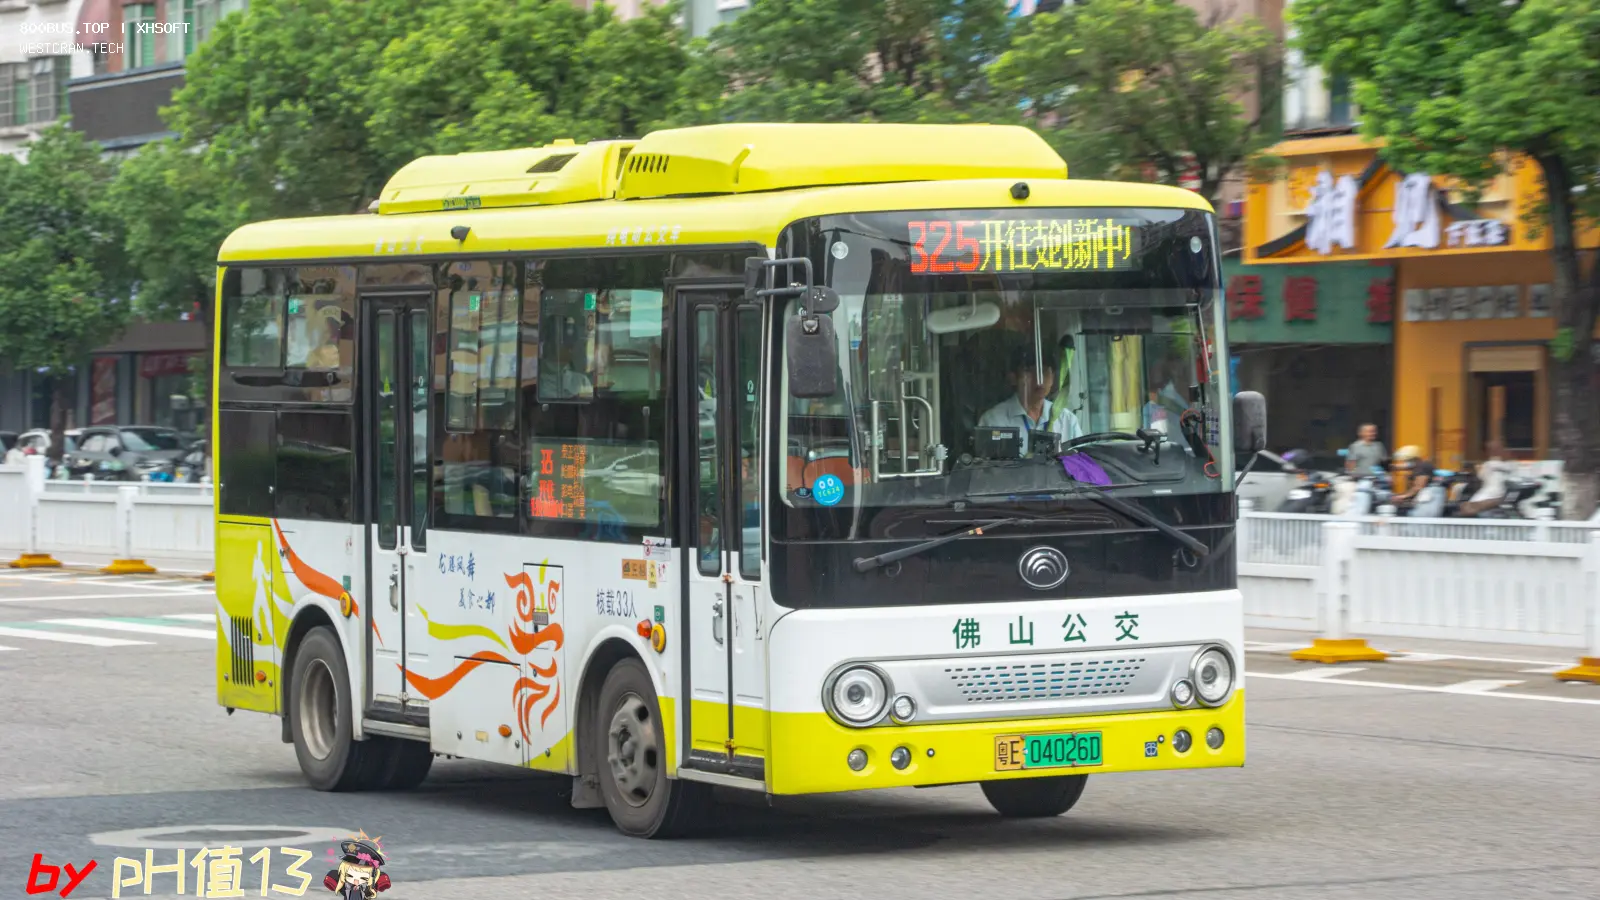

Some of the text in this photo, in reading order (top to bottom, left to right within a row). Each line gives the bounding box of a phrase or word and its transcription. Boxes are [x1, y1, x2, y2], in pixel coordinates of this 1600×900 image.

[908, 219, 981, 273] 325
[596, 588, 637, 618] 核载33人
[952, 611, 1139, 649] 佛山公交
[1029, 736, 1100, 764] 04026D
